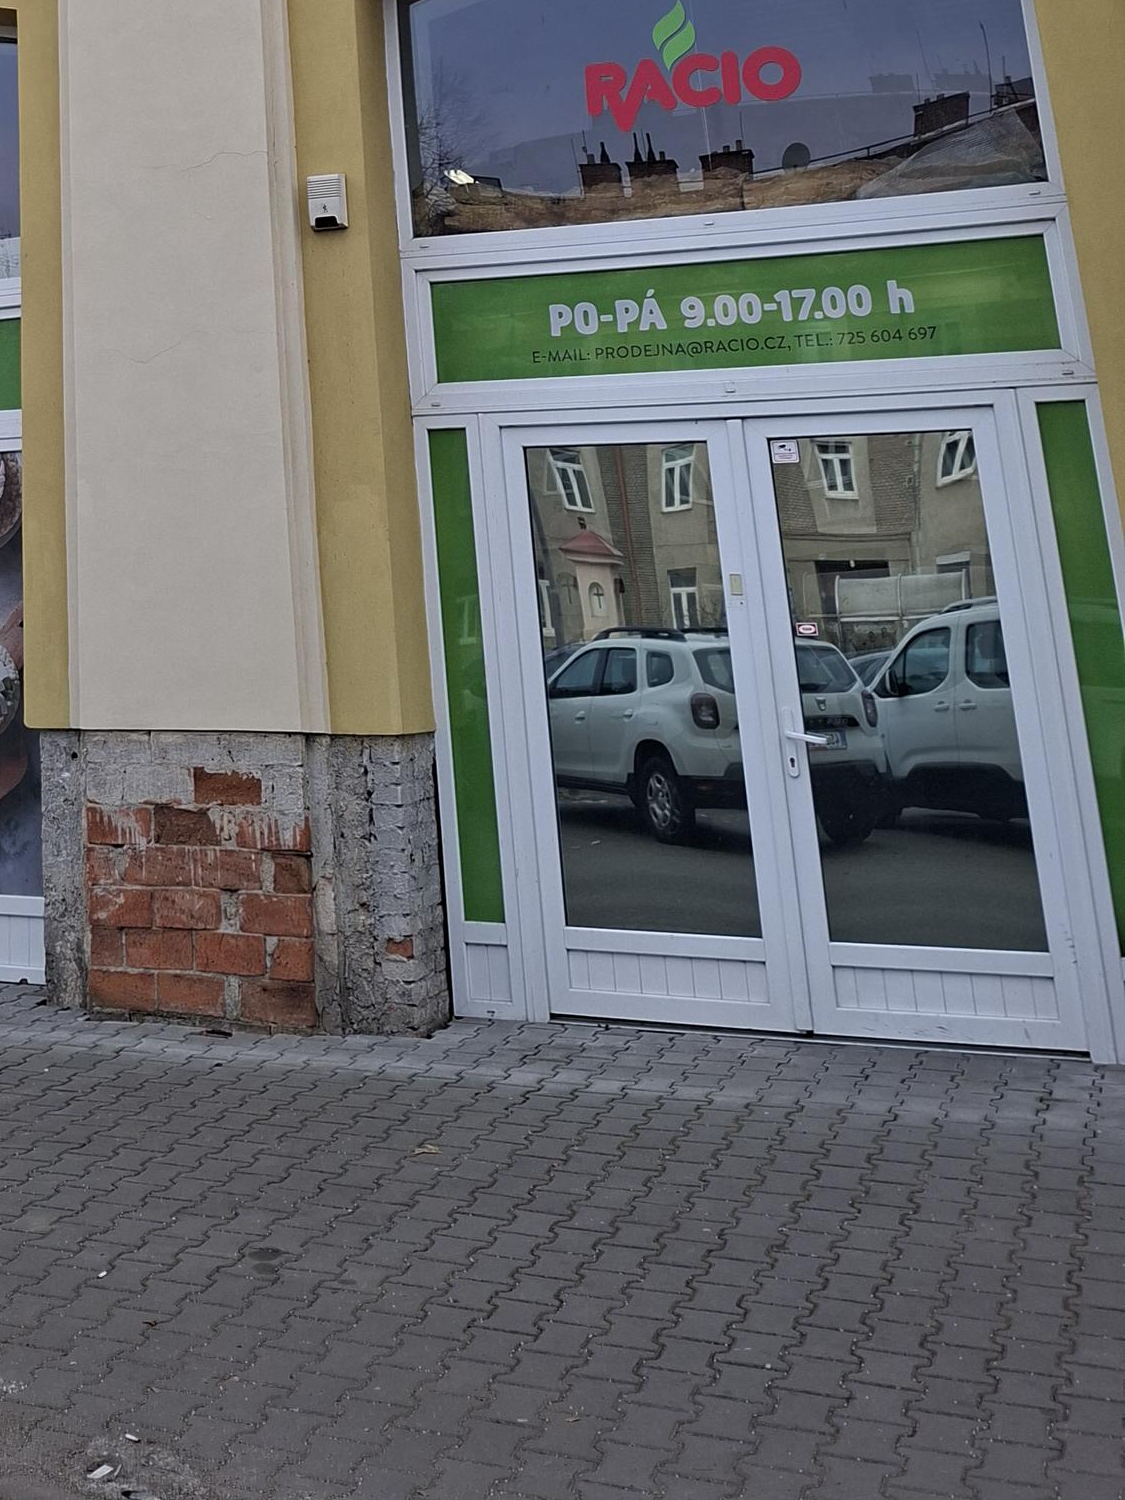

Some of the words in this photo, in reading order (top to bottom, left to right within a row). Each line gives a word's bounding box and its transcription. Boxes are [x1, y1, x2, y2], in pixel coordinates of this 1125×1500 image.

[584, 45, 802, 133] RACIO
[548, 289, 668, 337] PO-PÁ
[680, 284, 873, 329] 9.00-17.00
[886, 279, 916, 314] h
[532, 349, 591, 364] E-MAIL:
[595, 335, 792, 360] PRODEJNA@RACIO.CZ,
[794, 332, 833, 348] TEL.:
[837, 330, 866, 346] 725
[870, 328, 903, 342] 604
[908, 326, 937, 341] 697
